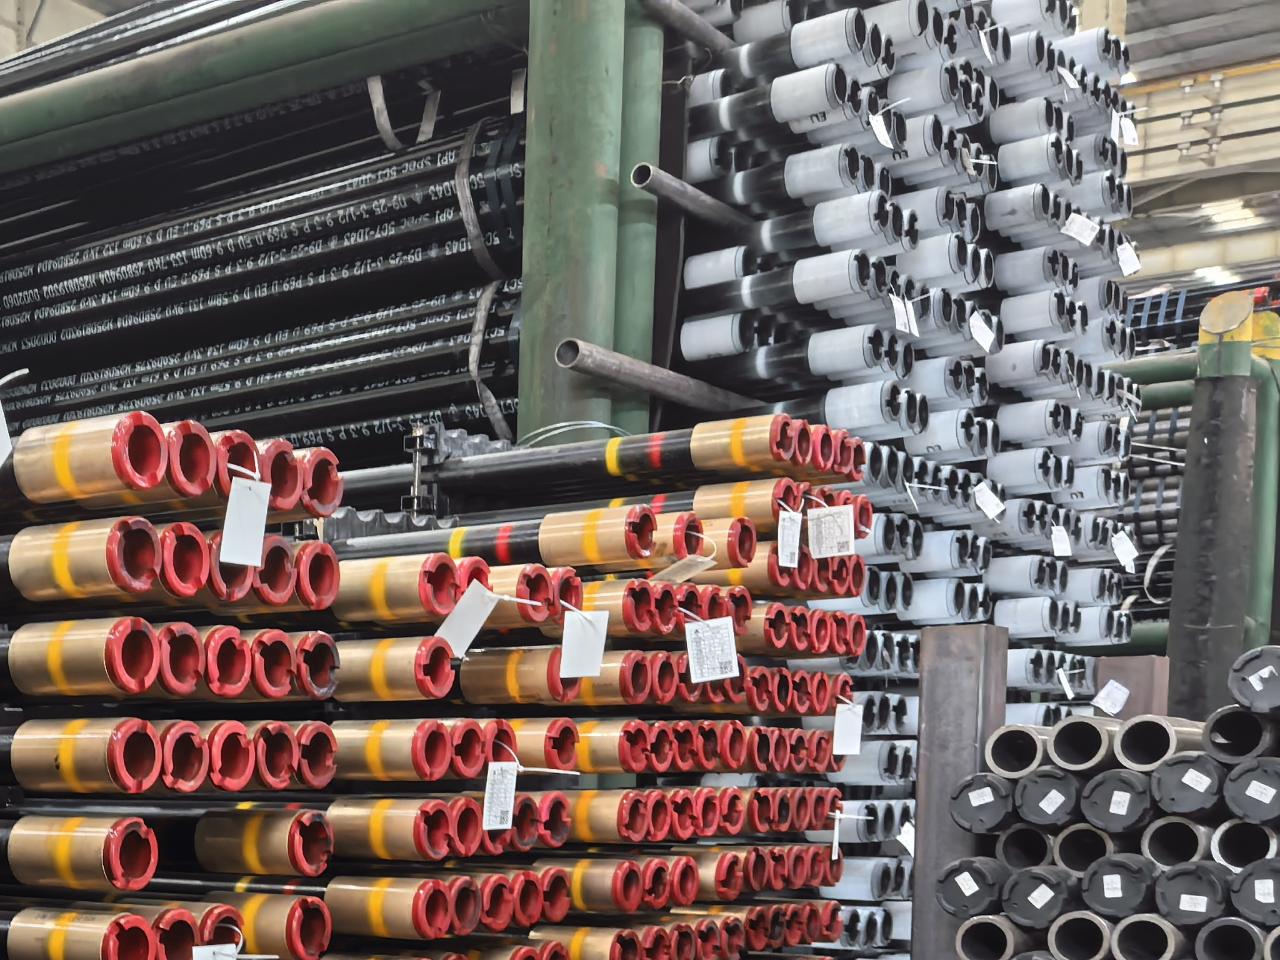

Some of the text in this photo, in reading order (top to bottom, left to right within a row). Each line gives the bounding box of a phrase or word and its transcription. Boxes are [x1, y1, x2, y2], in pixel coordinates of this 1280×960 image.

[810, 111, 827, 124] EU
[435, 152, 457, 166] API
[312, 213, 334, 229] 9.3
[336, 204, 369, 223] 3-1/2
[432, 207, 456, 223] API
[236, 233, 252, 250] EU
[328, 264, 350, 280] 9.3
[253, 282, 269, 297] EU
[349, 423, 369, 437] 9.3
